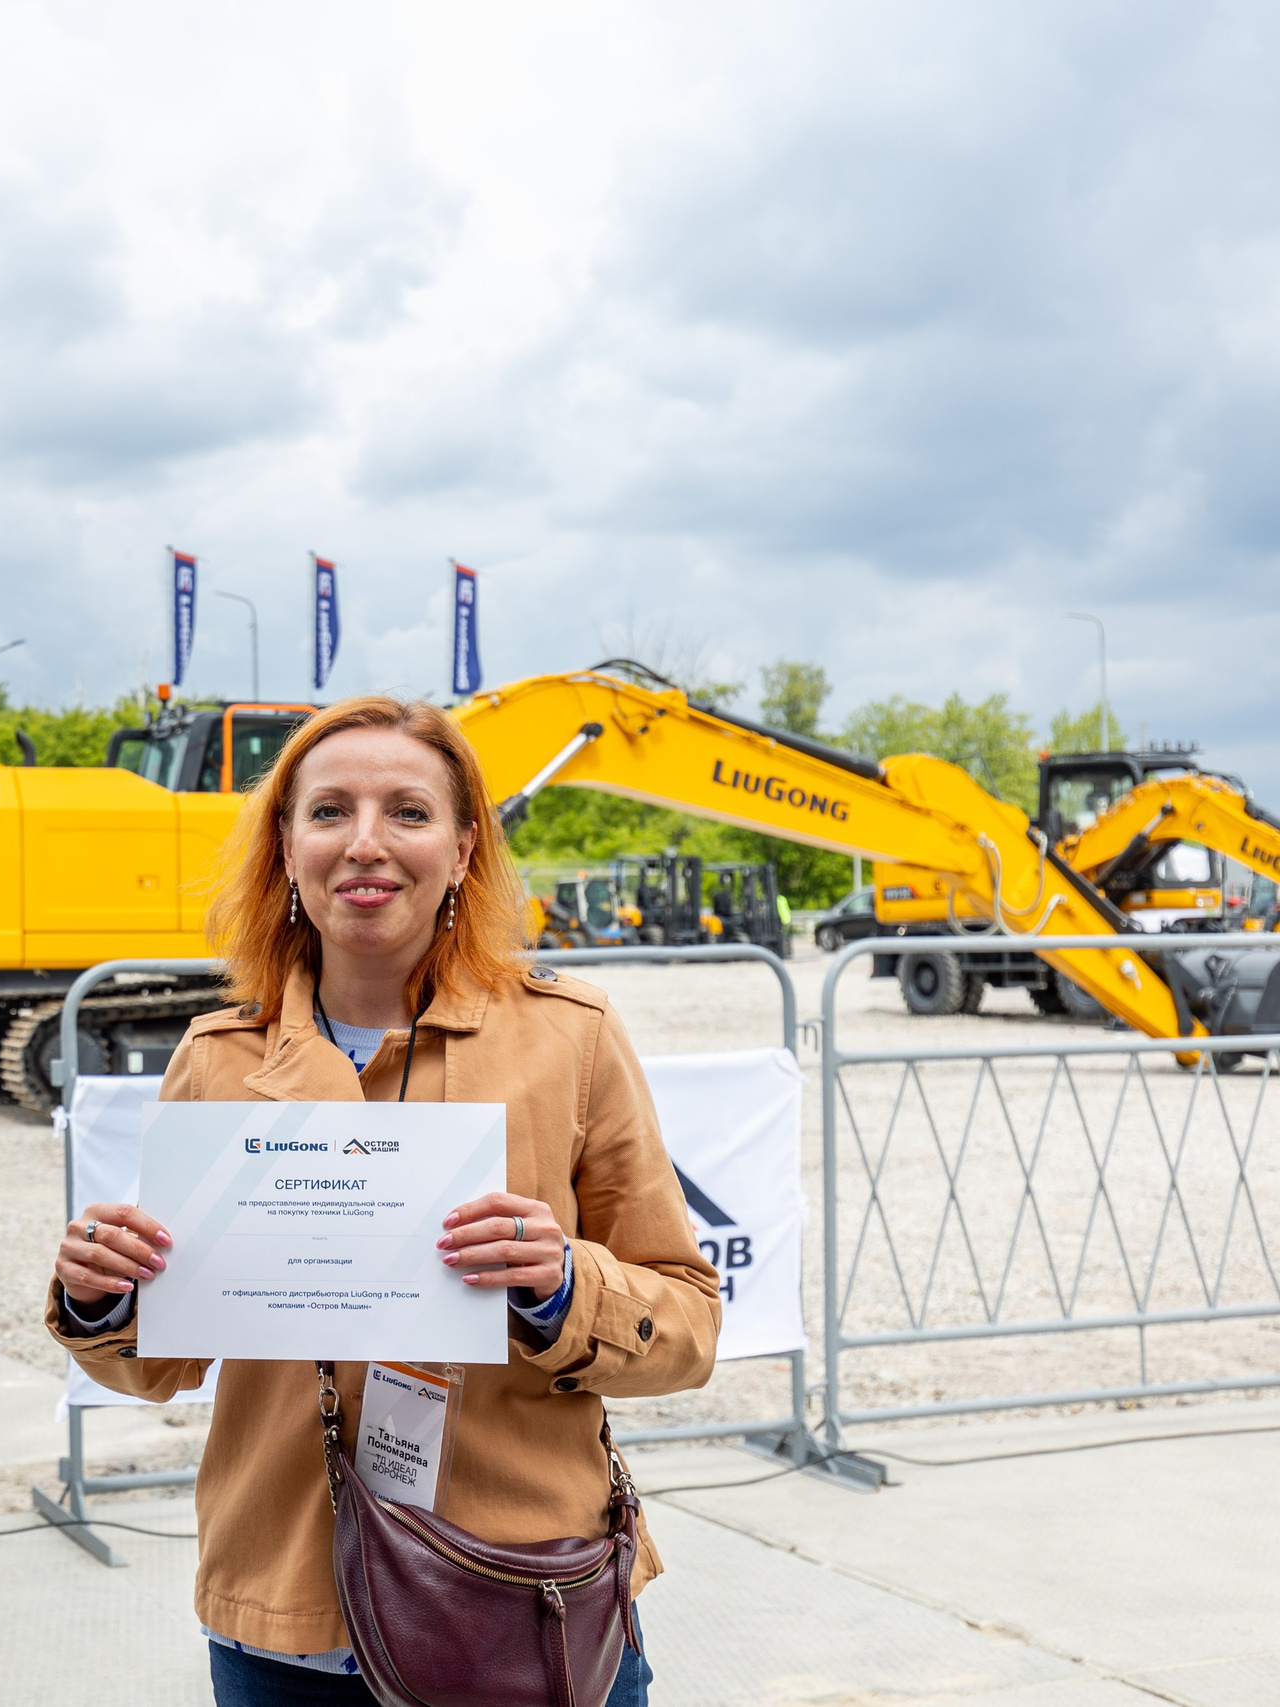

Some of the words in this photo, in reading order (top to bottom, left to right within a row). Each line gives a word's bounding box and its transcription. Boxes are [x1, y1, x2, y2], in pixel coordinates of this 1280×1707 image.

[363, 1140, 400, 1148] ОСТРОВ
[274, 1179, 368, 1190] СЕРТИФИКАТ
[312, 1200, 376, 1208] индивидуальной
[278, 1209, 309, 1217] покупку
[342, 1209, 374, 1217] LiuGong
[232, 1289, 288, 1298] официального
[289, 1290, 349, 1298] дистрибьютора
[350, 1290, 383, 1299] LiuGong
[390, 1291, 420, 1299] России
[378, 1427, 421, 1454] Татьяна
[367, 1435, 429, 1468] Пономарева
[376, 1453, 387, 1466] ТД
[388, 1459, 418, 1478] ИДЕАЛ
[372, 1462, 417, 1488] ВОРОНЕЖ
